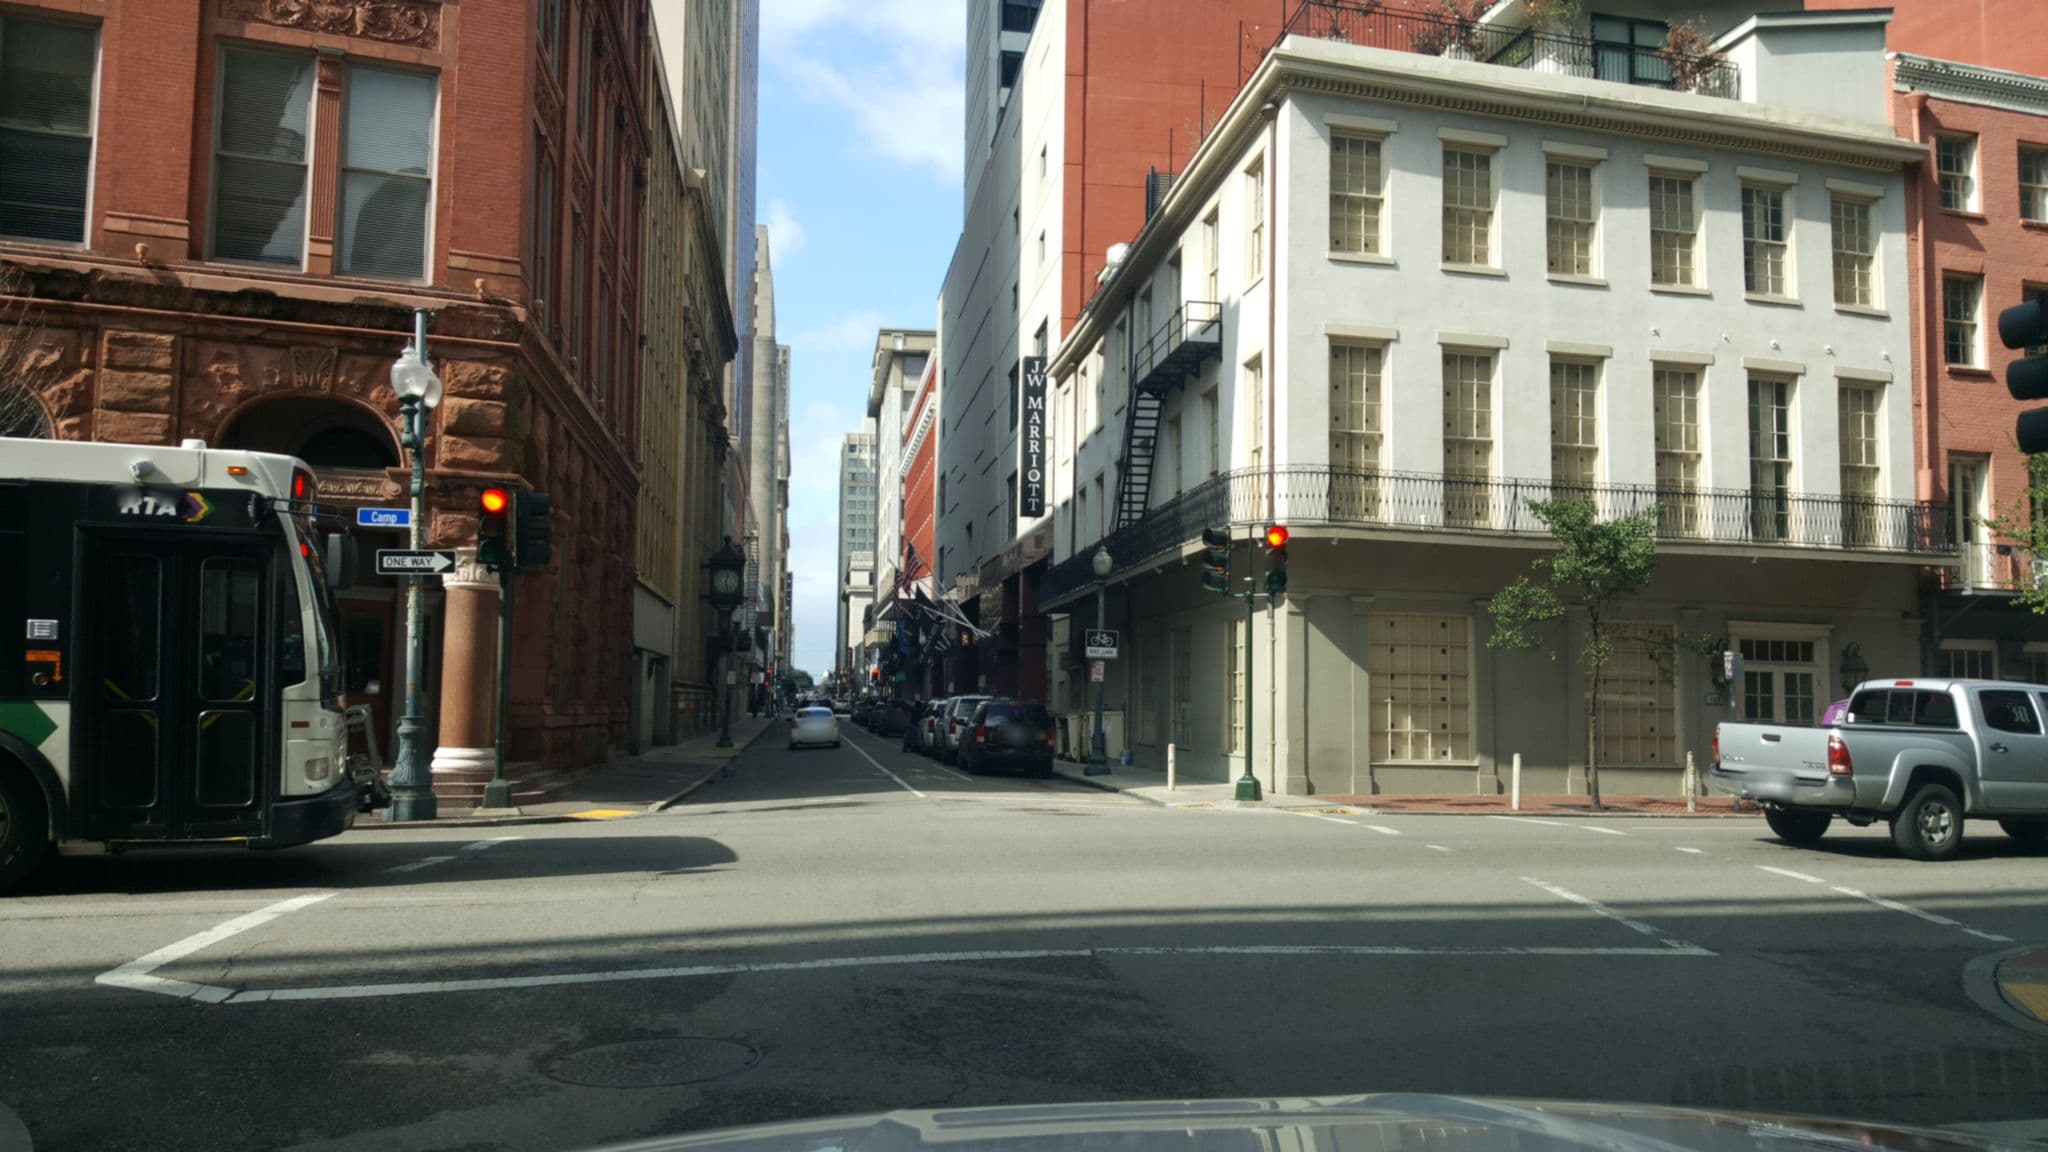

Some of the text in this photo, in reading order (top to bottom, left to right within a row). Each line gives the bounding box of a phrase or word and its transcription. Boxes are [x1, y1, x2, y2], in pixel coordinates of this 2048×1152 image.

[1027, 361, 1044, 511] JW MARRIOTT
[371, 511, 397, 524] Camp
[386, 557, 432, 567] ONE WAY
